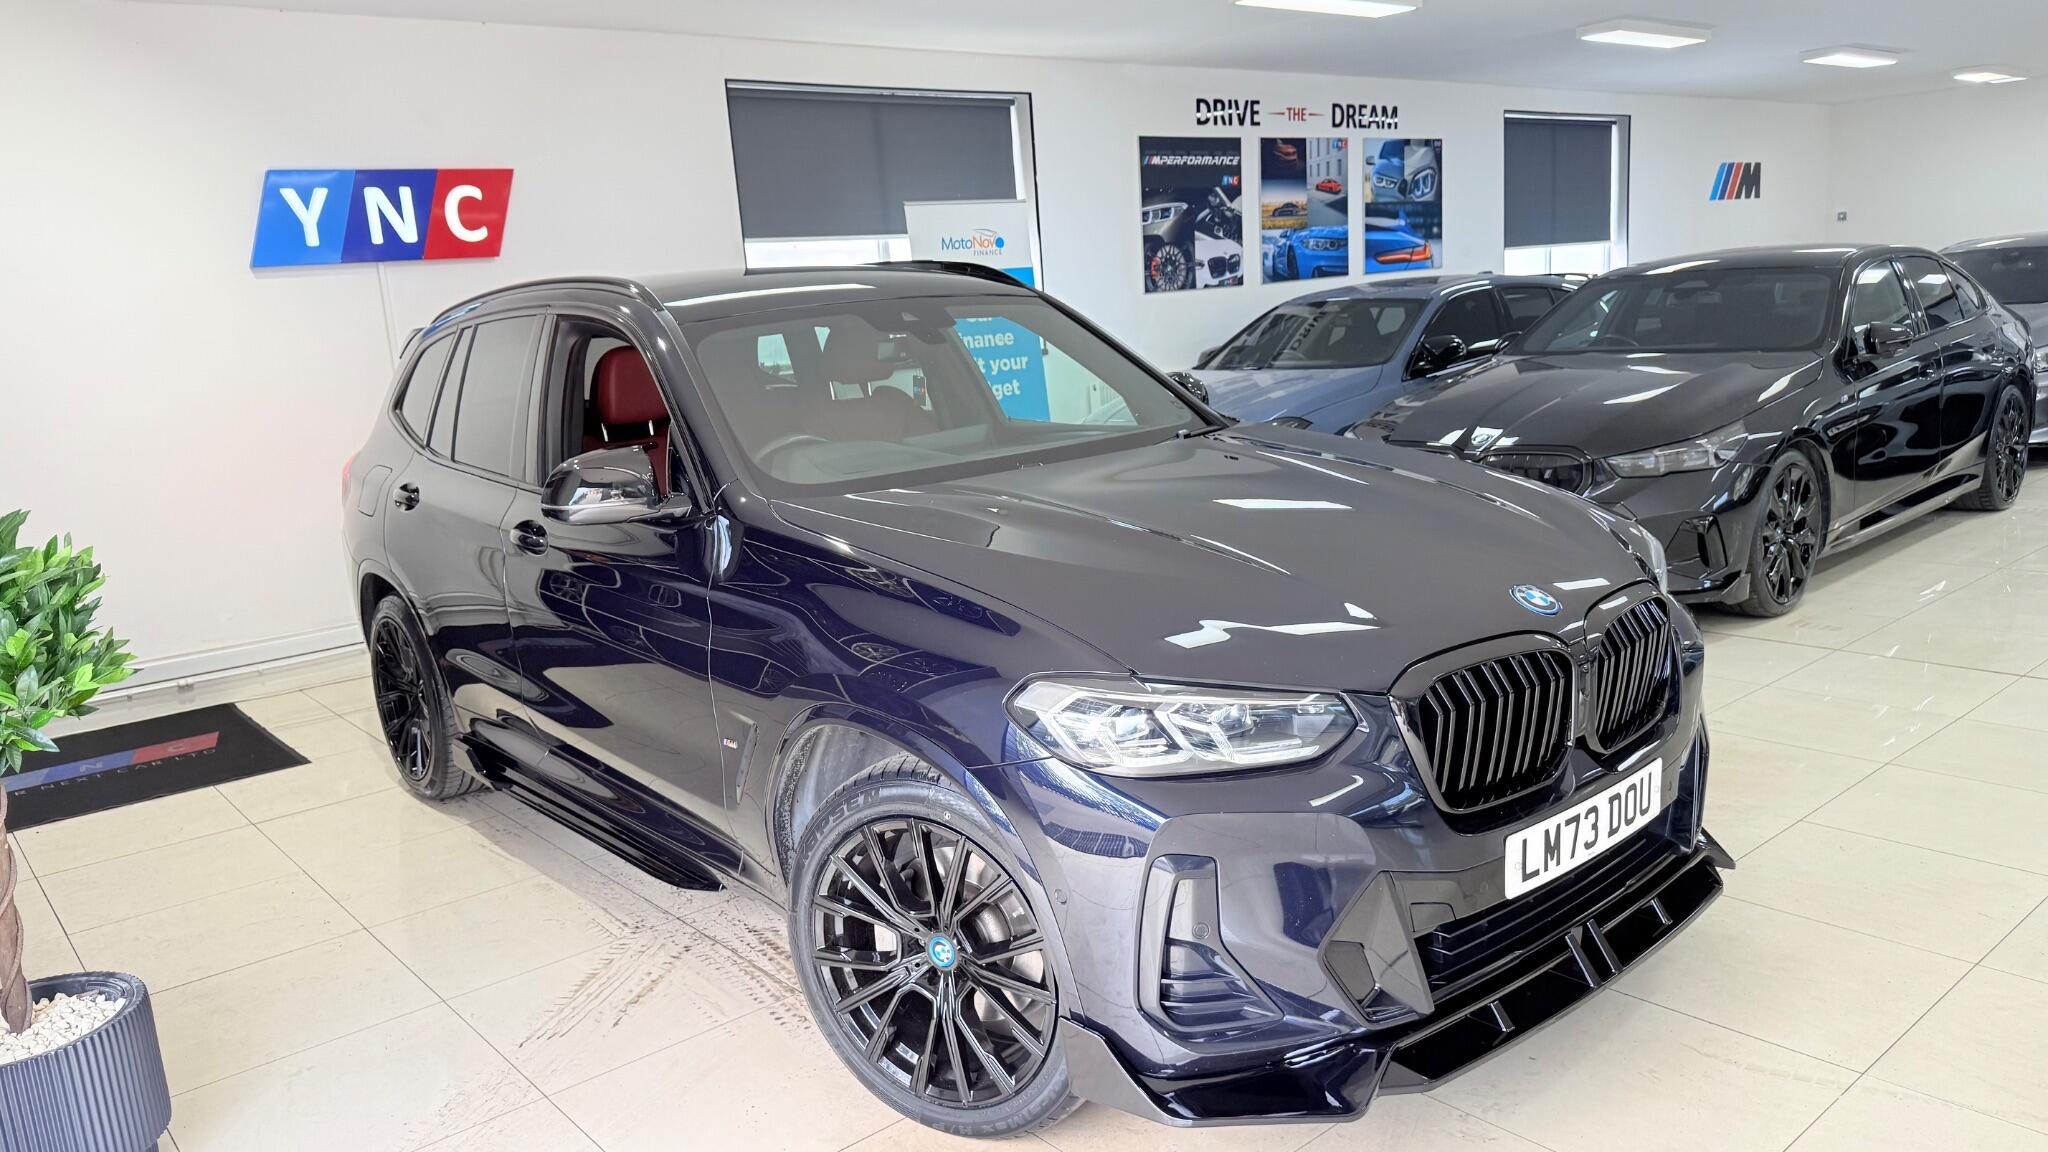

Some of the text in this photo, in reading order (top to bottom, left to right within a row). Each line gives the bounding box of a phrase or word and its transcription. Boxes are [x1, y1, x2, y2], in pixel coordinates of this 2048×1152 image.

[1196, 98, 1399, 130] DRIVE THE DREAM
[279, 184, 489, 247] YNC
[958, 332, 1014, 348] nance
[990, 357, 1028, 376] your
[988, 379, 1020, 401] get
[1521, 771, 1652, 883] LM73 DOU
